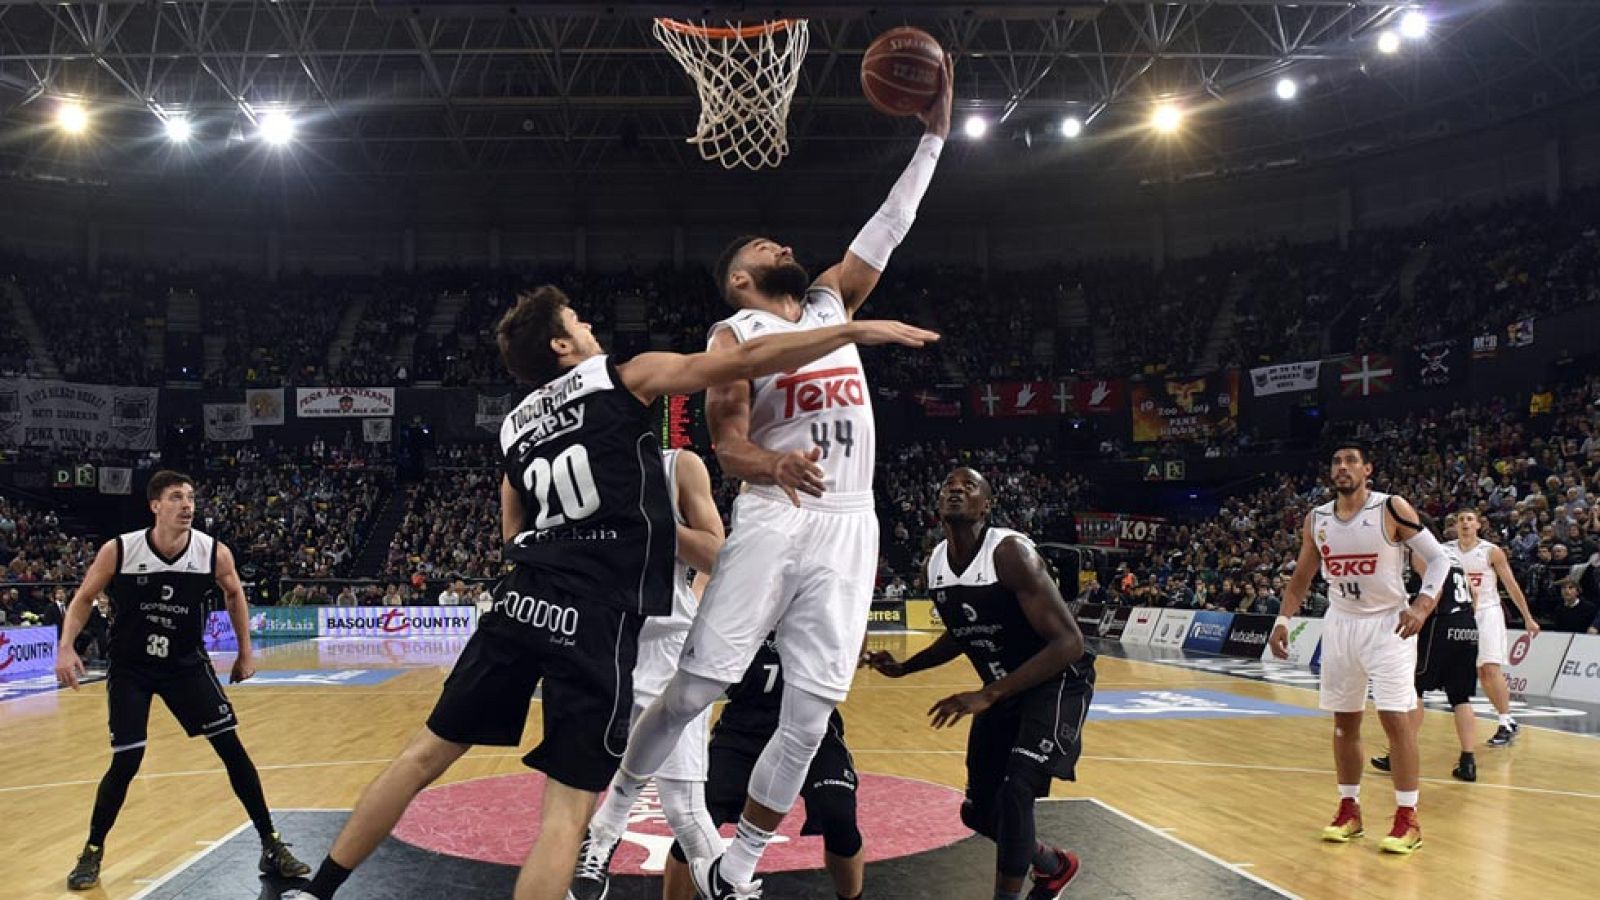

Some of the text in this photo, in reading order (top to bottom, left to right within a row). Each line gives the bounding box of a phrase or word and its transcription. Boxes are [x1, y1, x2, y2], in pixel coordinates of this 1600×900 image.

[811, 420, 853, 459] 44
[523, 444, 600, 529] 20
[1338, 582, 1361, 600] 14
[327, 616, 385, 630] BASQUE
[402, 616, 469, 629] COUNTRY
[146, 633, 170, 658] 33
[1562, 660, 1581, 676] EL
